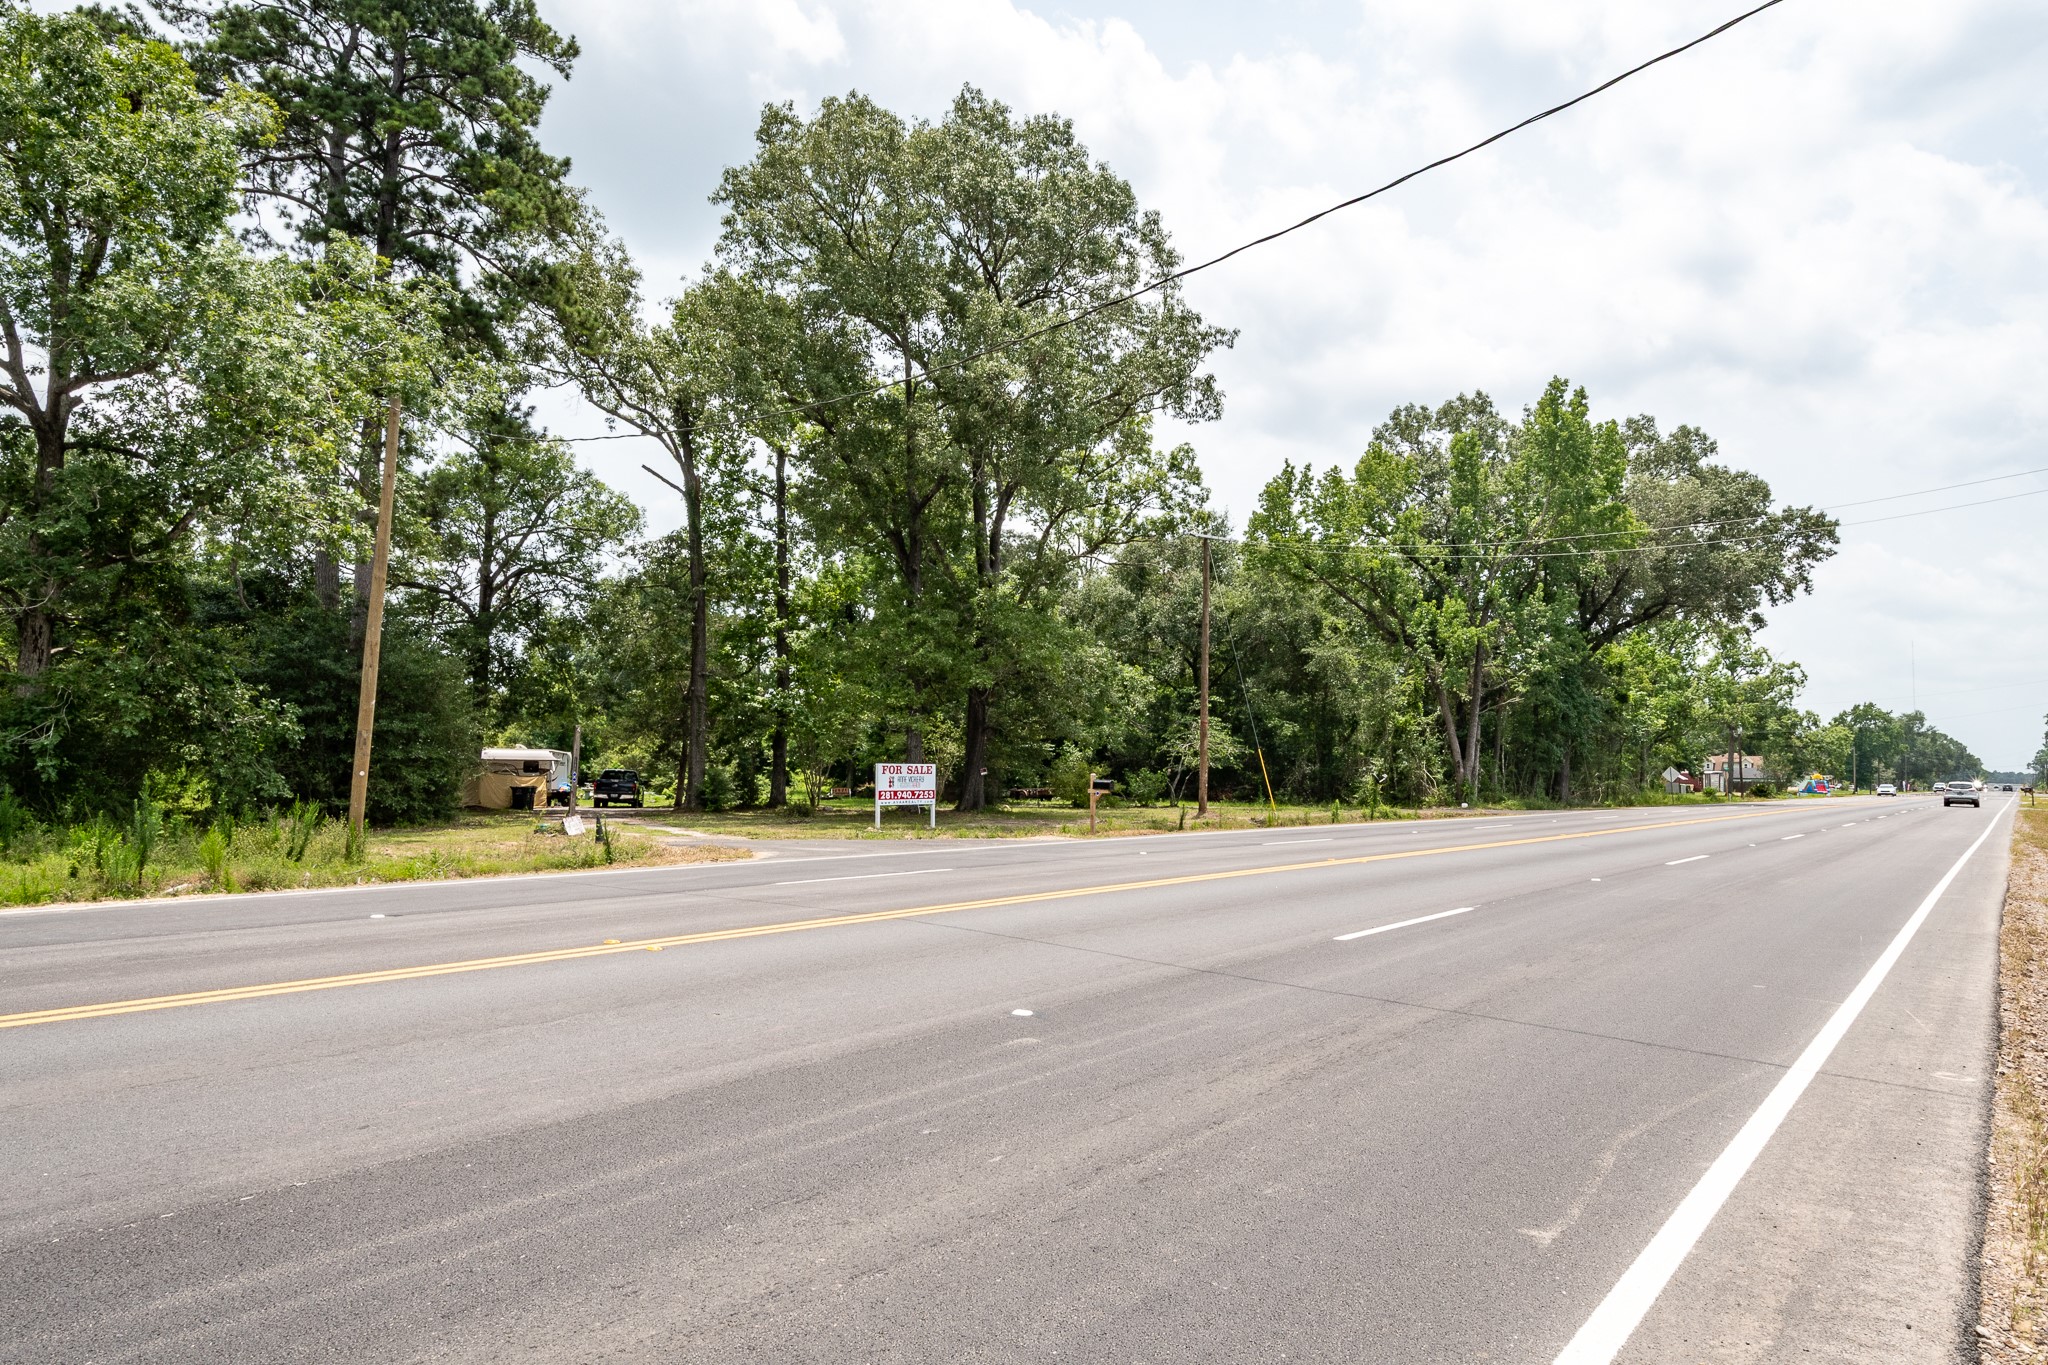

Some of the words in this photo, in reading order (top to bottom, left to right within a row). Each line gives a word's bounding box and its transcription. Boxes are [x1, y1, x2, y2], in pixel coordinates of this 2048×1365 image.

[882, 766, 902, 774] FOR
[906, 766, 932, 774] SALE
[880, 791, 934, 799] 281.940.7253
